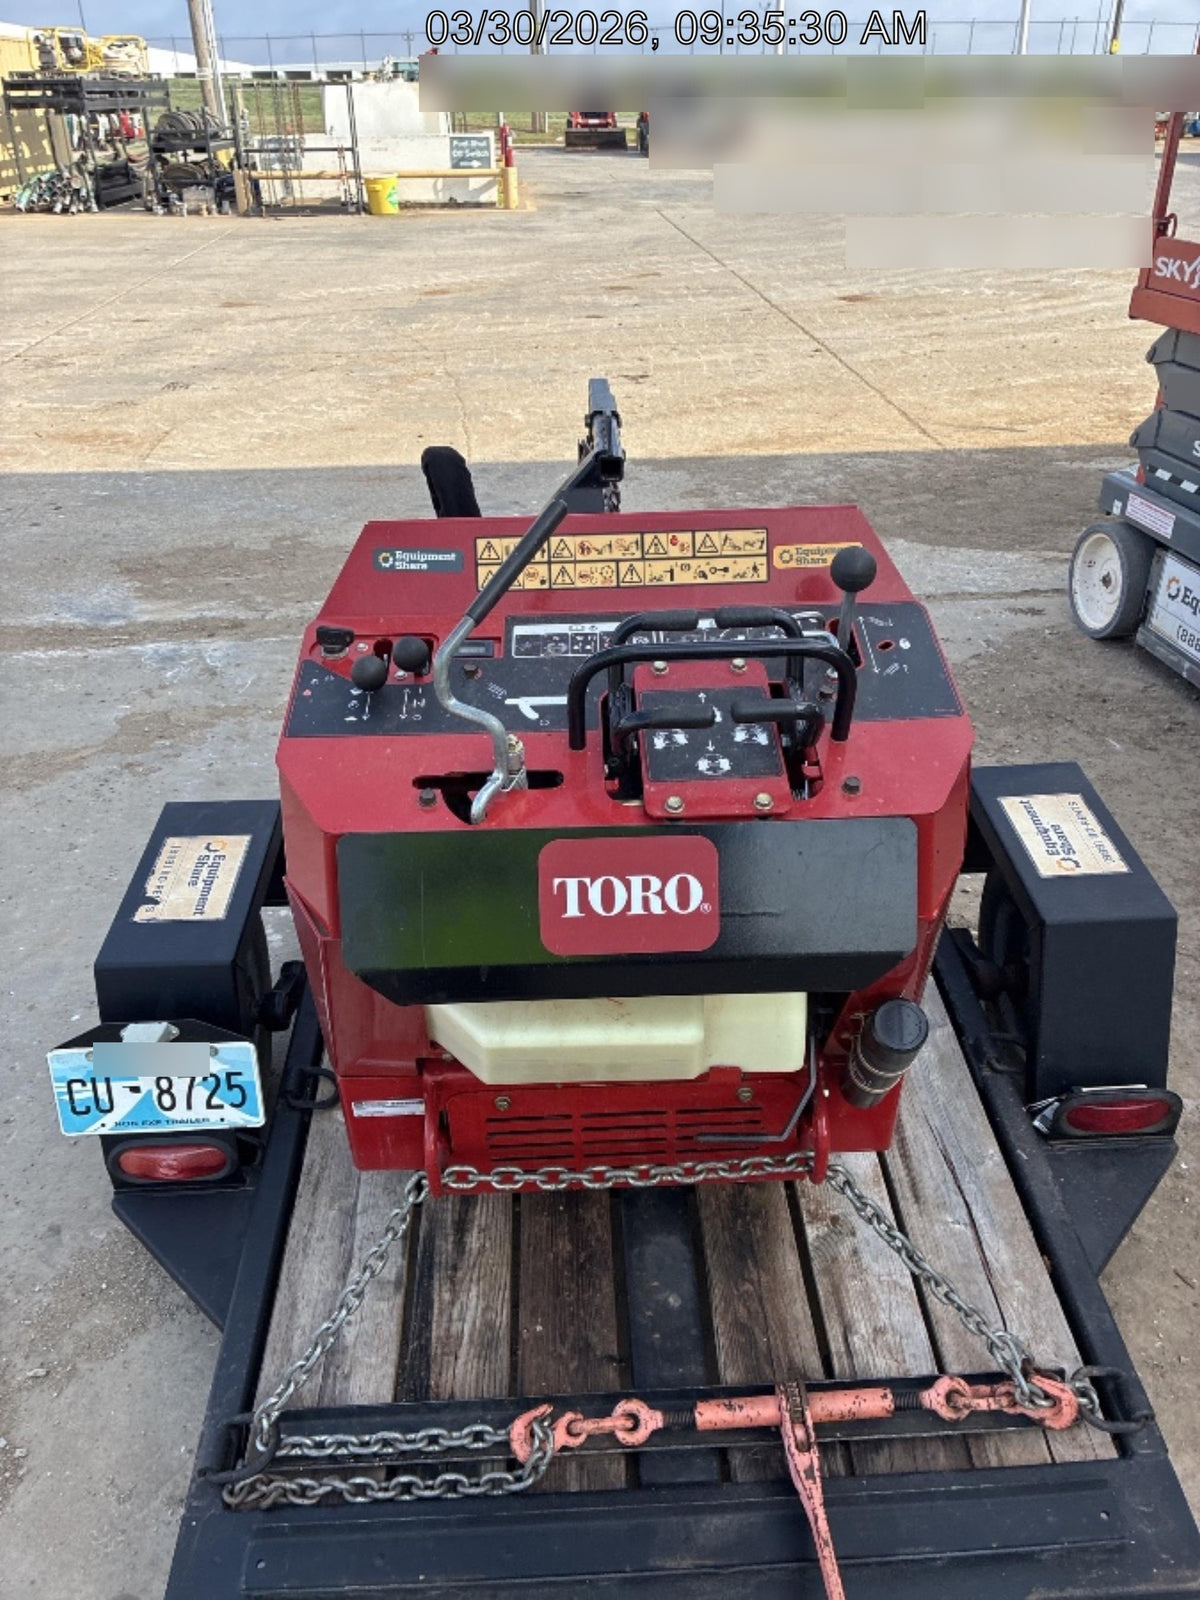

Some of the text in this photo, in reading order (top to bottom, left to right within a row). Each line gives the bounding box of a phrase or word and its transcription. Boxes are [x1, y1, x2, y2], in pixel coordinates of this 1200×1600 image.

[394, 561, 428, 570] Share
[395, 550, 456, 562] Equipment
[795, 556, 827, 566] Share
[1020, 800, 1060, 856] Equipment
[1051, 824, 1076, 856] Share
[188, 854, 210, 887] Share
[193, 854, 226, 916] Equipment
[66, 1071, 248, 1116] CU 8725
